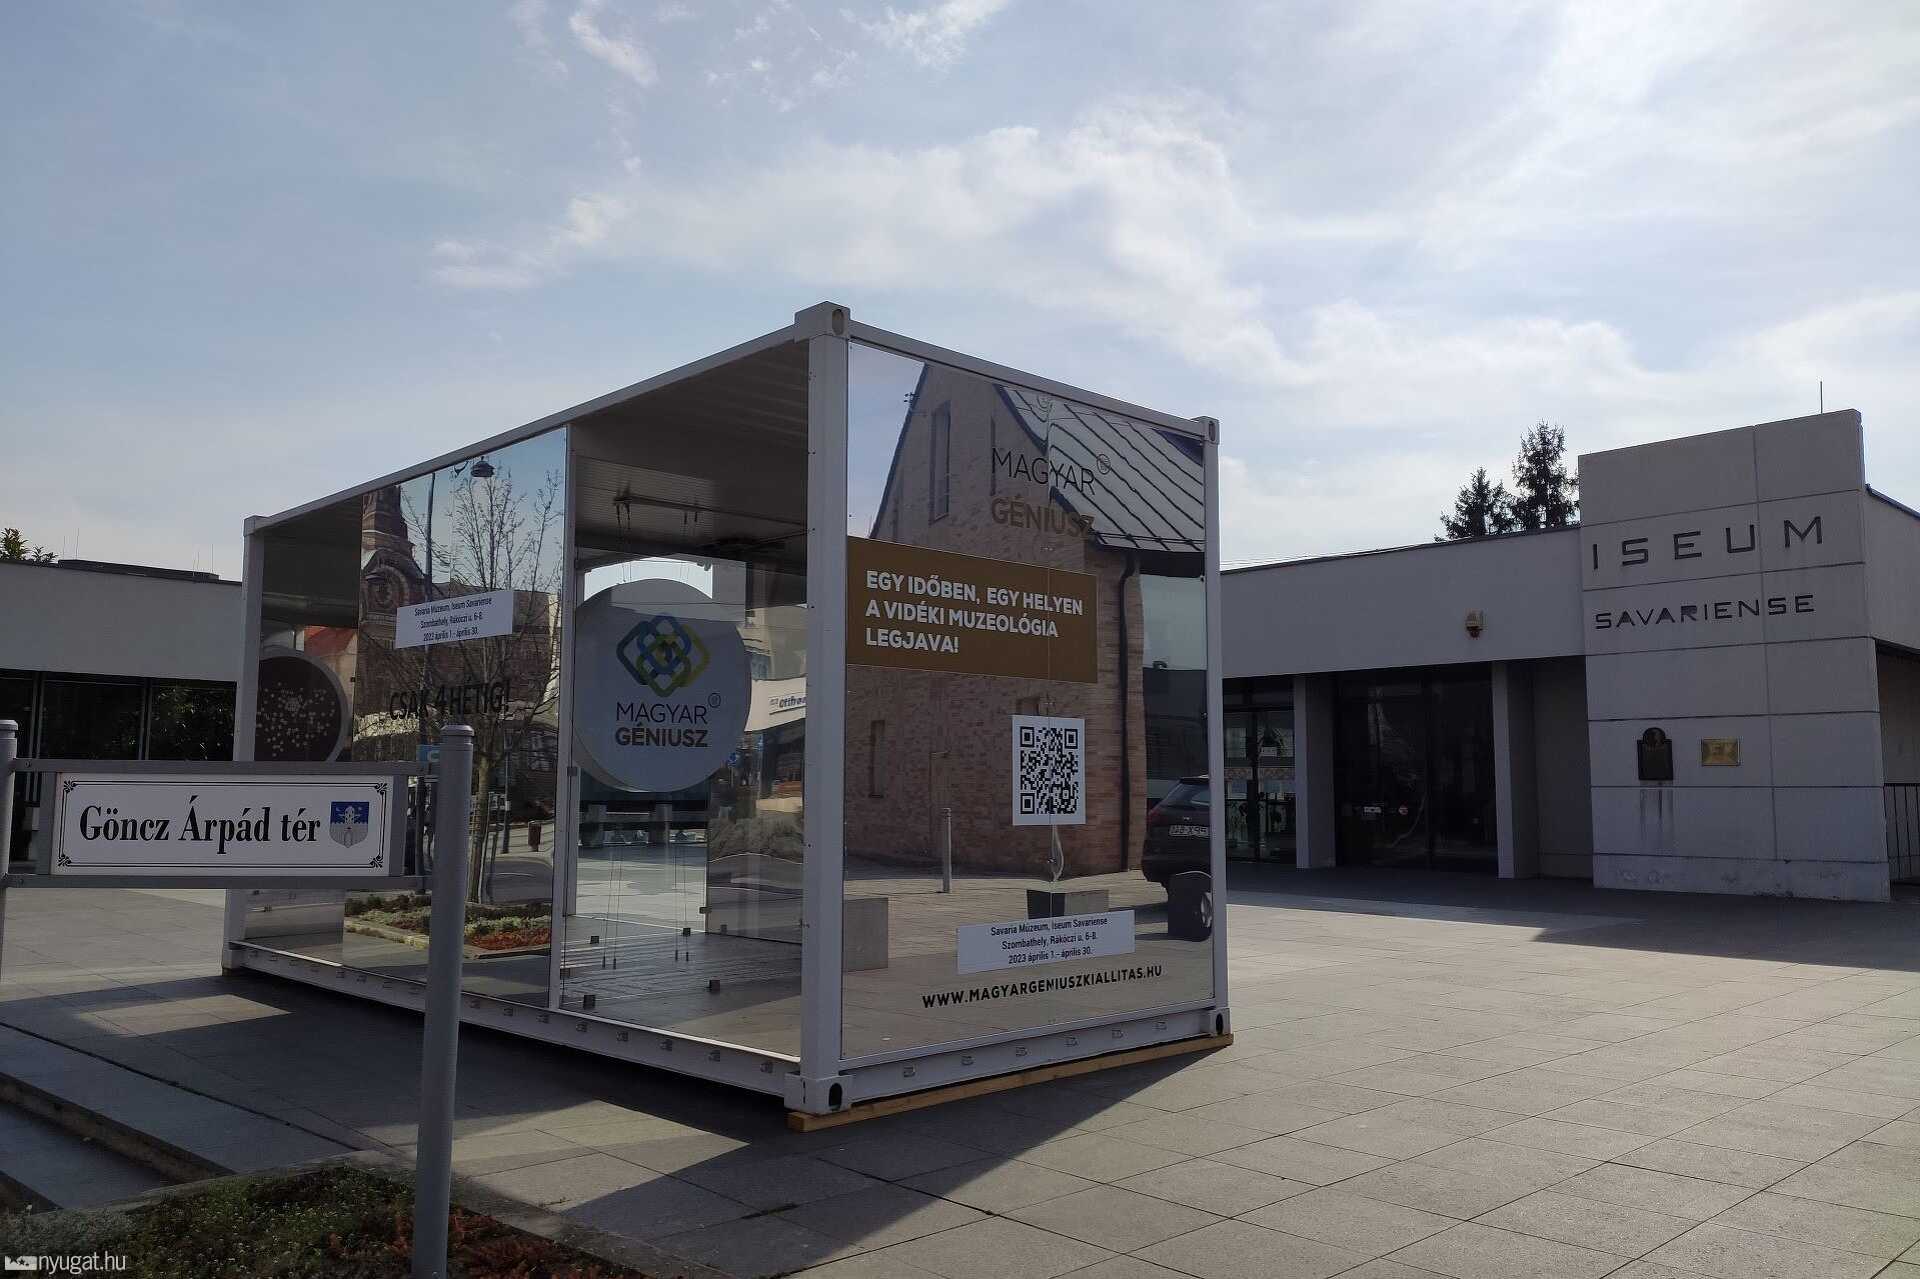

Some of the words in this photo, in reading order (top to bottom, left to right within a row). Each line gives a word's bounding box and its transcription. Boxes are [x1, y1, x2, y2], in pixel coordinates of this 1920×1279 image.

[991, 447, 1096, 496] MAGYAR
[990, 493, 1096, 538] GÉNIUSZ
[1592, 515, 1824, 570] ISEUM
[866, 570, 905, 592] EGY
[908, 574, 981, 606] IDŐBEN,
[986, 587, 1020, 606] EGY
[1022, 593, 1084, 617] HELYEN
[1595, 594, 1816, 629] SAVARIENSE
[865, 600, 881, 618] A
[884, 600, 945, 624] VIDÉKI
[949, 610, 1059, 639] MUZEOLÓGIA
[865, 628, 960, 653] LEGJAVA!
[616, 702, 708, 724] MAGYAR
[614, 722, 709, 748] GÉNIUSZ
[79, 804, 170, 842] Göncz
[178, 795, 270, 855] Árpád
[280, 807, 321, 842] tér
[990, 925, 1018, 936] Savaria
[1052, 920, 1072, 930] Iseum
[1073, 917, 1108, 928] Savariense
[1008, 954, 1027, 964] 2023
[922, 965, 1163, 1008] WWW.MAGYARGENIUSZKIALLITAS.HU
